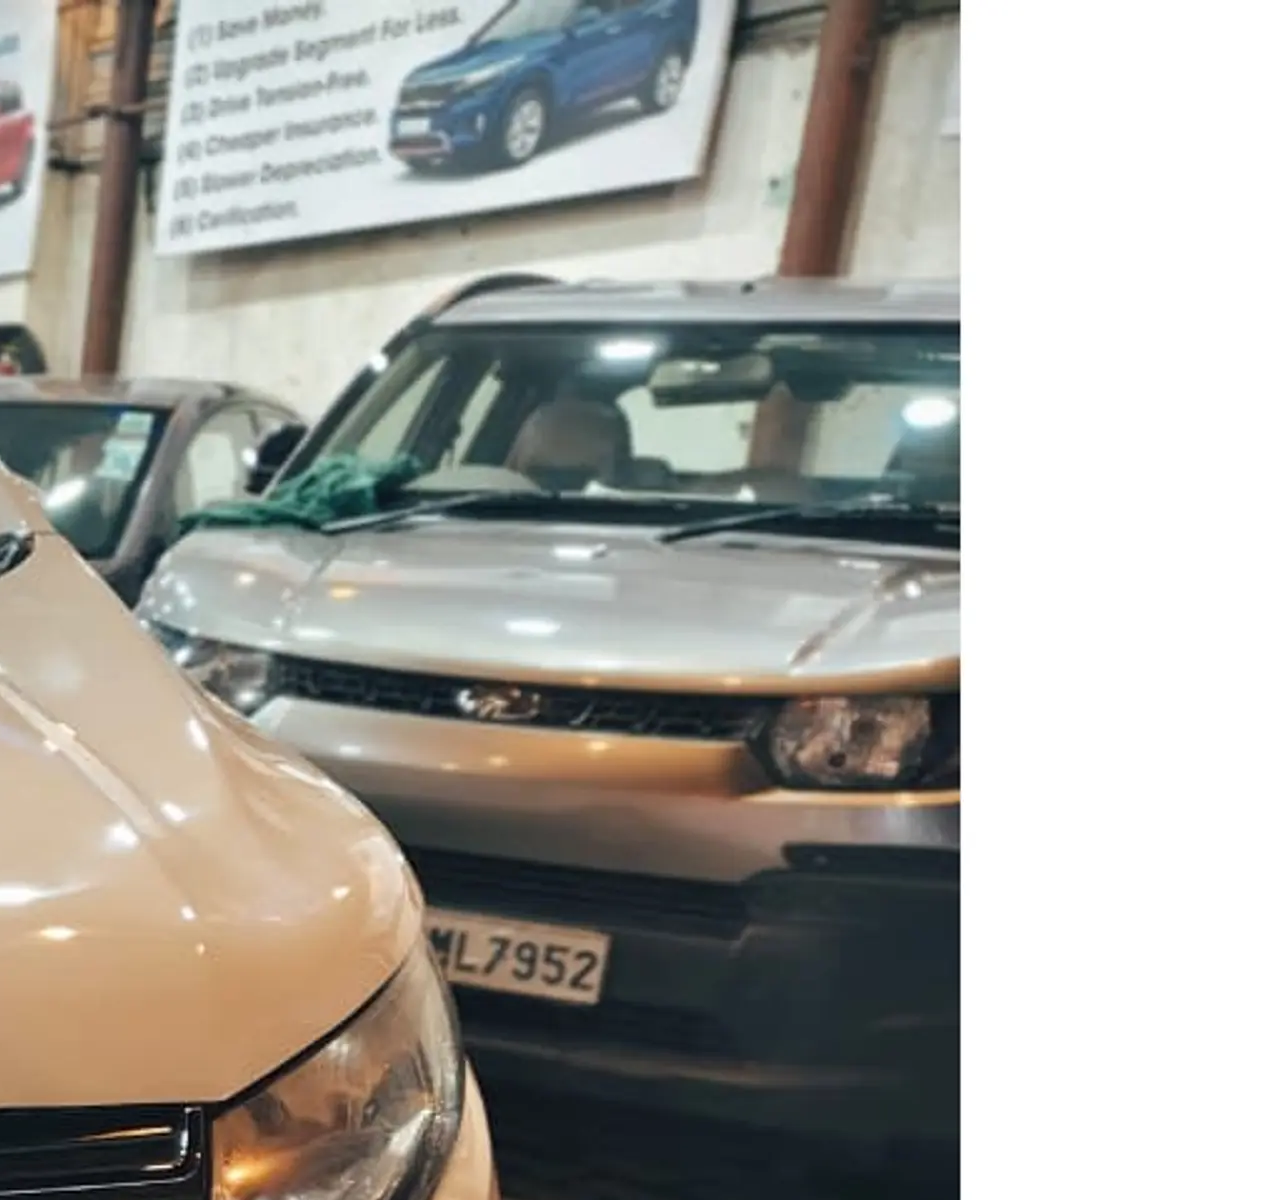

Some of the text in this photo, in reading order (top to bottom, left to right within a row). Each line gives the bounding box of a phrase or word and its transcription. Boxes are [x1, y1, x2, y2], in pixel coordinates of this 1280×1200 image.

[217, 17, 258, 41] Save
[213, 49, 289, 80] Upgrade
[293, 24, 376, 62] Segment
[380, 17, 410, 41] For
[209, 95, 250, 118] Drive
[205, 126, 281, 156] Cheaper
